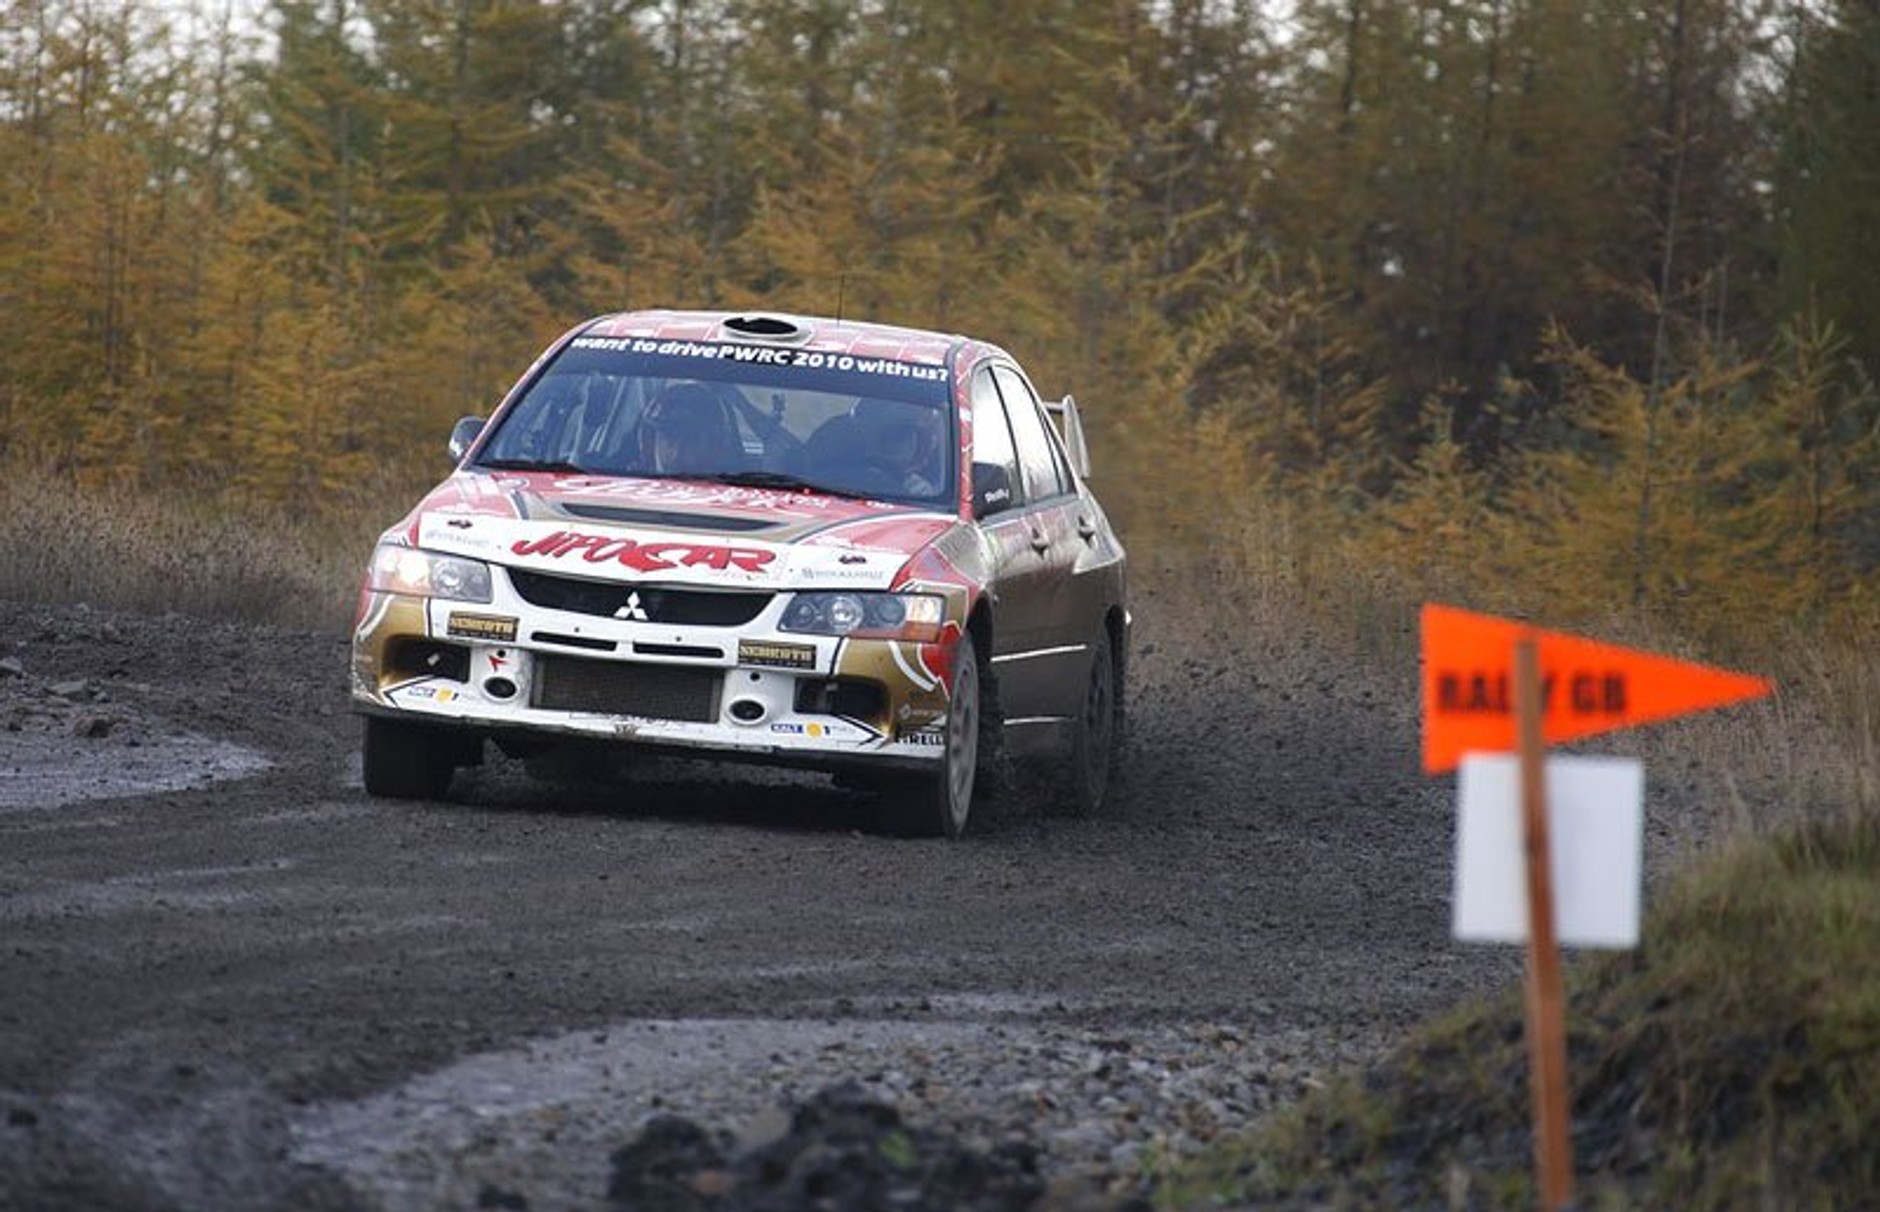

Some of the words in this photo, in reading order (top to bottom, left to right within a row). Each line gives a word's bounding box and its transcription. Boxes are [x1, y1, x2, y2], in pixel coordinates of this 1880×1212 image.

[571, 338, 631, 350] want
[632, 339, 657, 353] to
[658, 342, 717, 358] drive
[717, 345, 790, 364] PWRC
[793, 352, 854, 370] 2010
[857, 360, 909, 377] with
[912, 367, 949, 382] us?
[510, 530, 777, 573] JIPOCAR
[1438, 670, 1558, 713] RALY
[1571, 671, 1627, 713] GB
